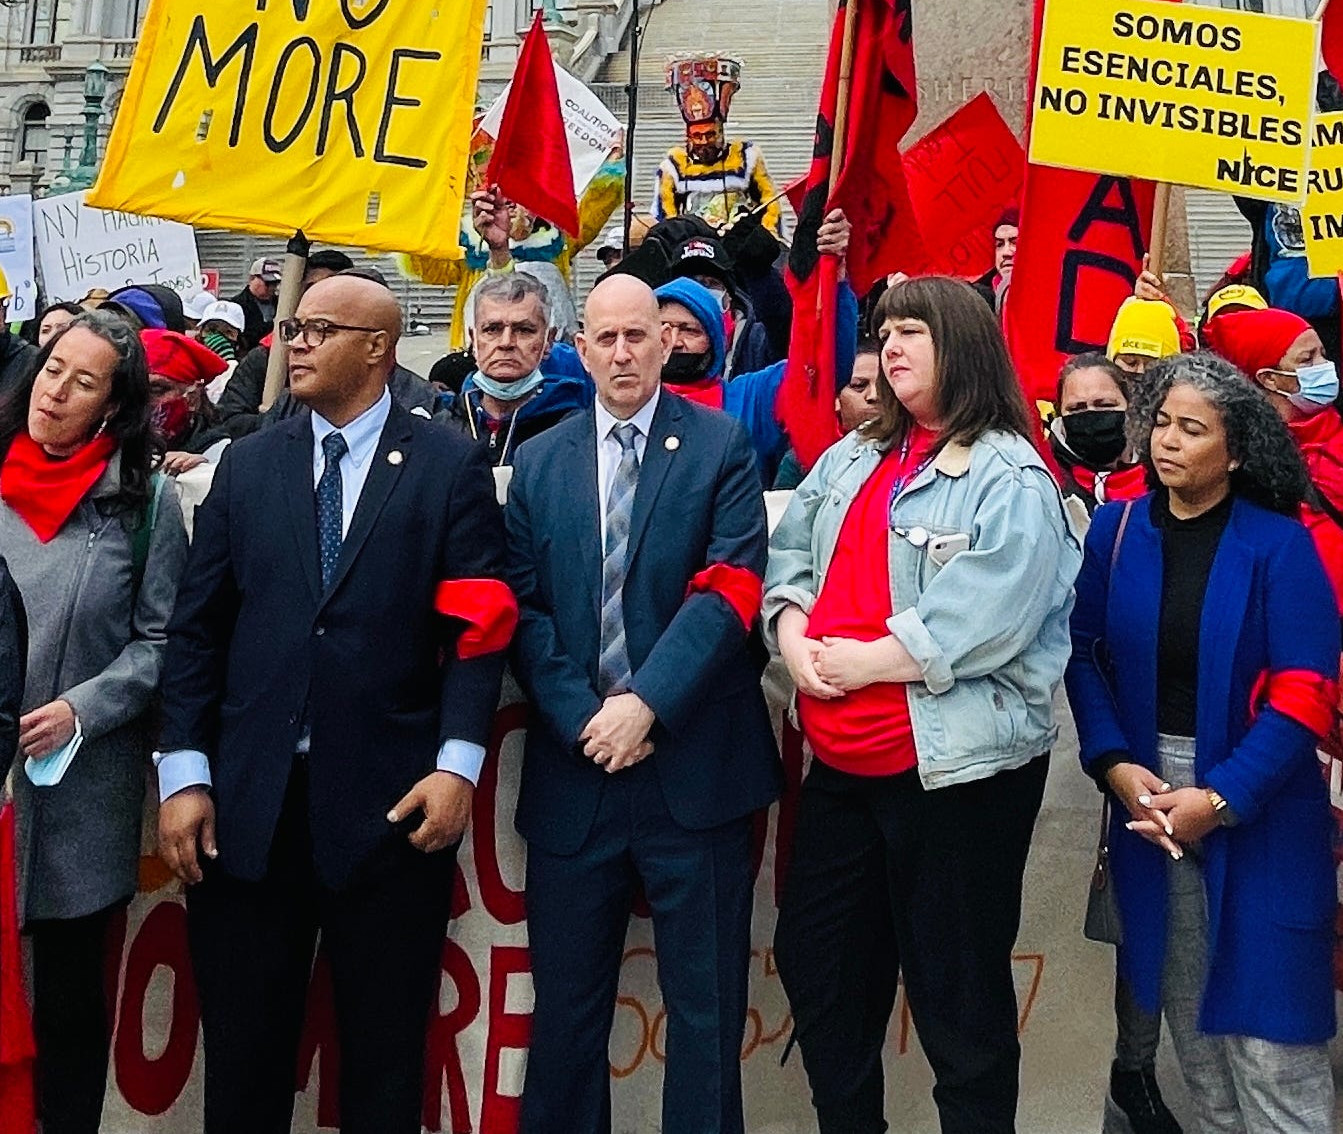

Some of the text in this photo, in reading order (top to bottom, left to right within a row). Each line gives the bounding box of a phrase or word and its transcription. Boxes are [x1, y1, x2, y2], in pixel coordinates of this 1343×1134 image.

[1112, 11, 1242, 52] SOMOS
[152, 14, 442, 169] MORE
[1061, 46, 1286, 106] ESENCIALES,
[1039, 86, 1303, 146] NO INVISIBLES
[40, 199, 81, 243] NY
